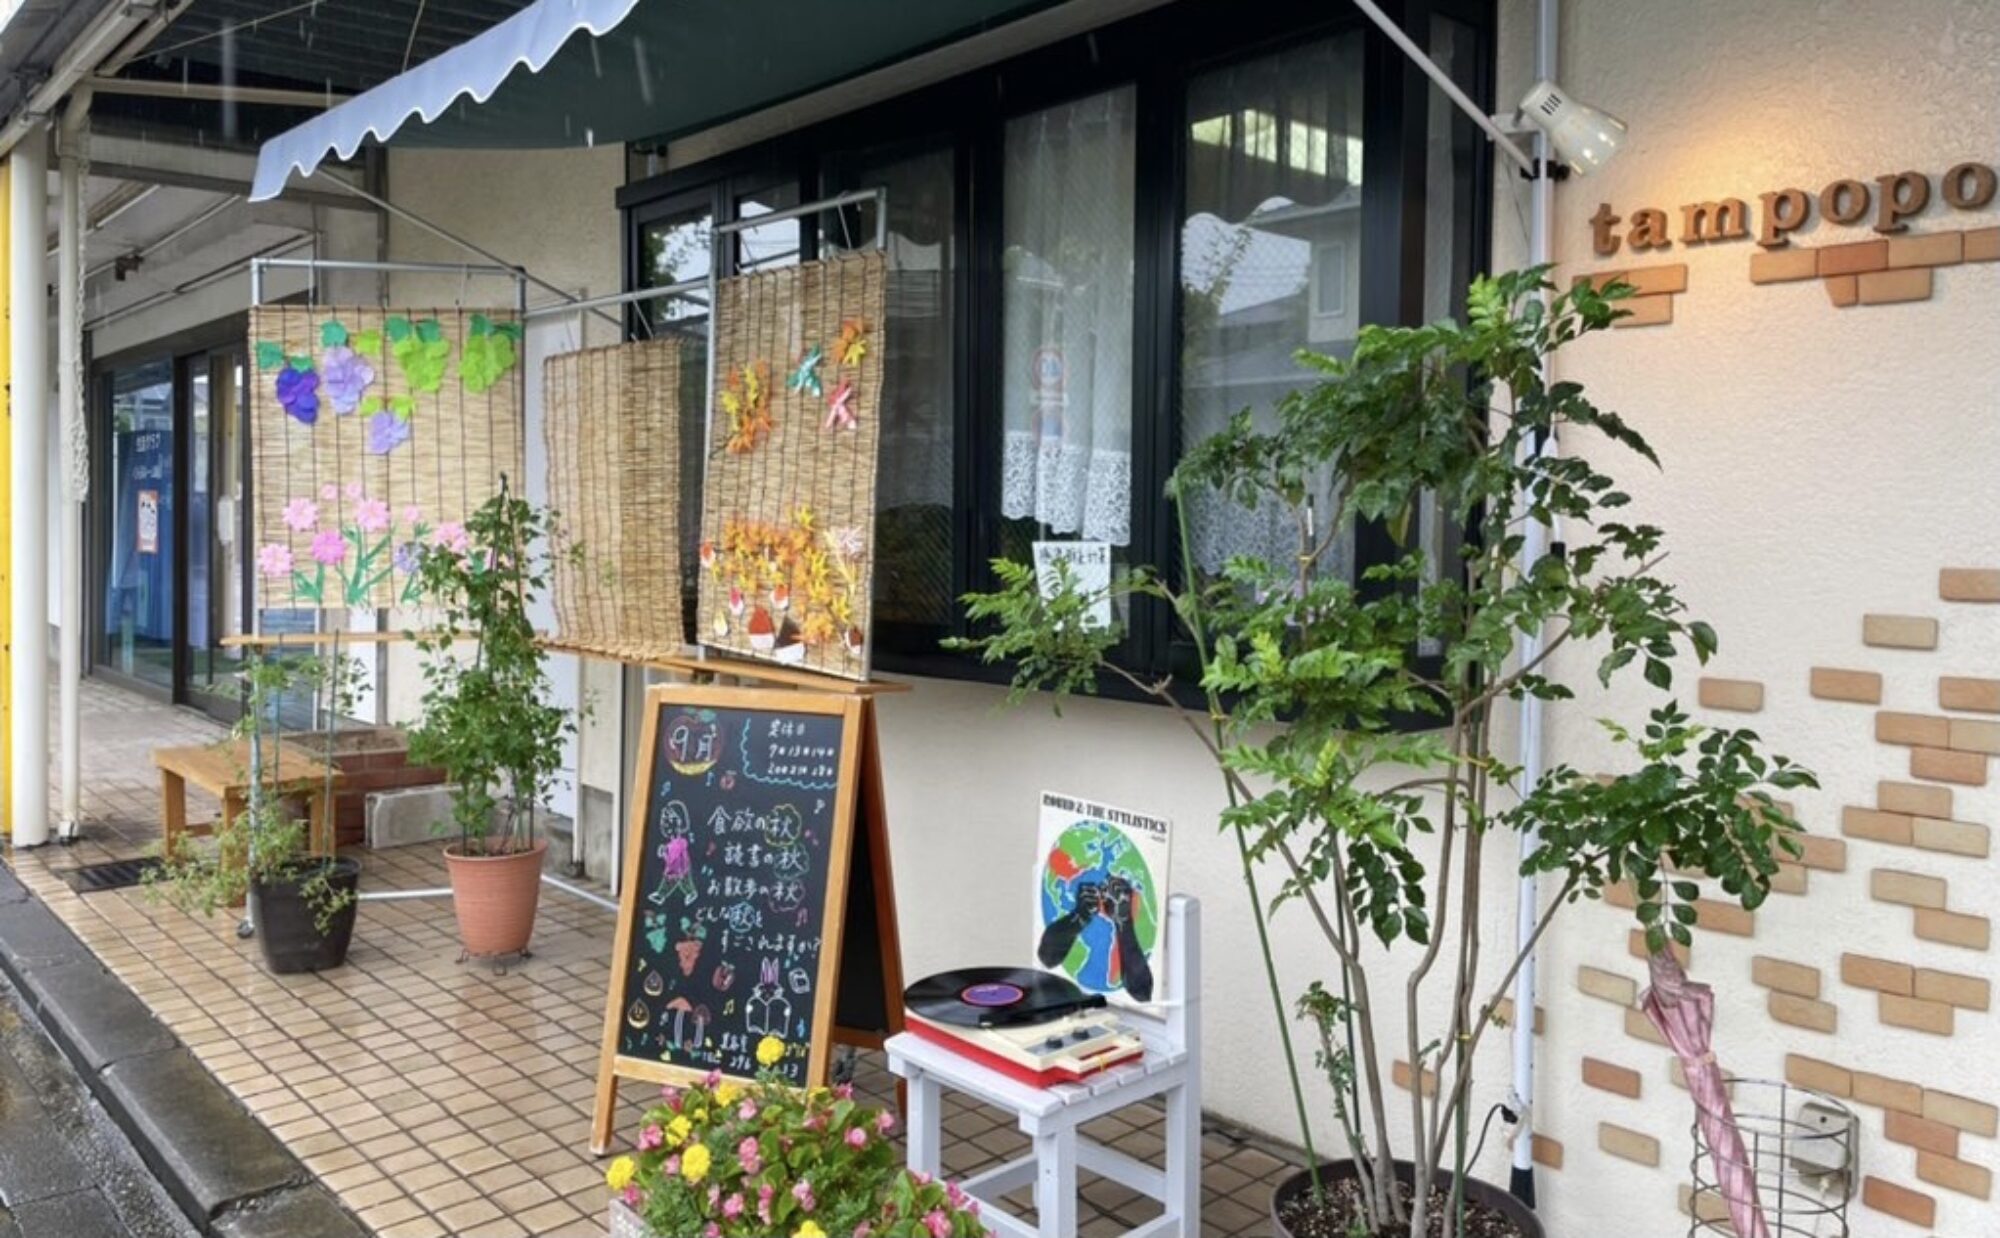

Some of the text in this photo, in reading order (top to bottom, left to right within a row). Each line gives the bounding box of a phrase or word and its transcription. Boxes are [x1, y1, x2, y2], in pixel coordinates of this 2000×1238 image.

[1588, 161, 1998, 256] tampopo
[706, 804, 796, 839] 食欲の秋
[1108, 809, 1168, 834] STYLISTICS
[724, 843, 803, 870] 読書の秋
